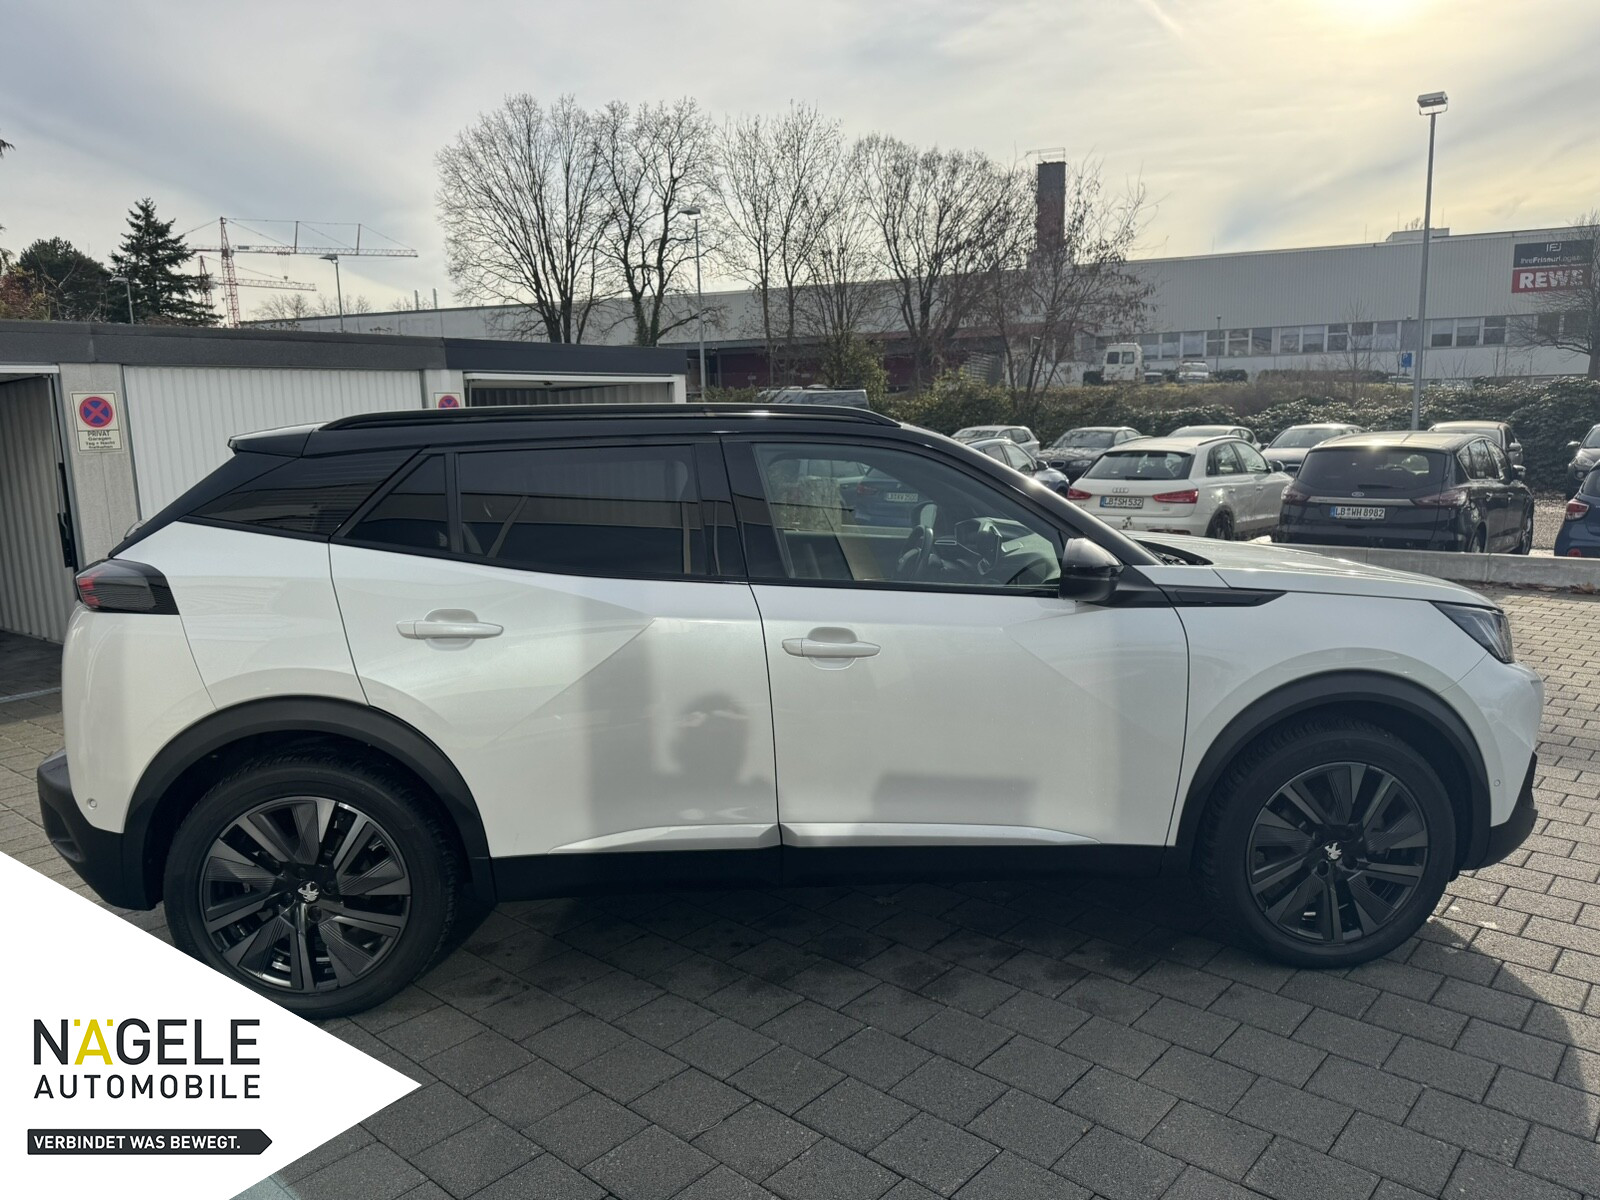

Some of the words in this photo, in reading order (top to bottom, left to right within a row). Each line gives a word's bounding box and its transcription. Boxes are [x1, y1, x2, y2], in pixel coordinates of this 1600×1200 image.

[1519, 270, 1583, 289] REWE
[1128, 498, 1142, 506] 532
[1335, 507, 1346, 516] LB
[1351, 507, 1362, 517] WH
[1363, 508, 1384, 517] 8982
